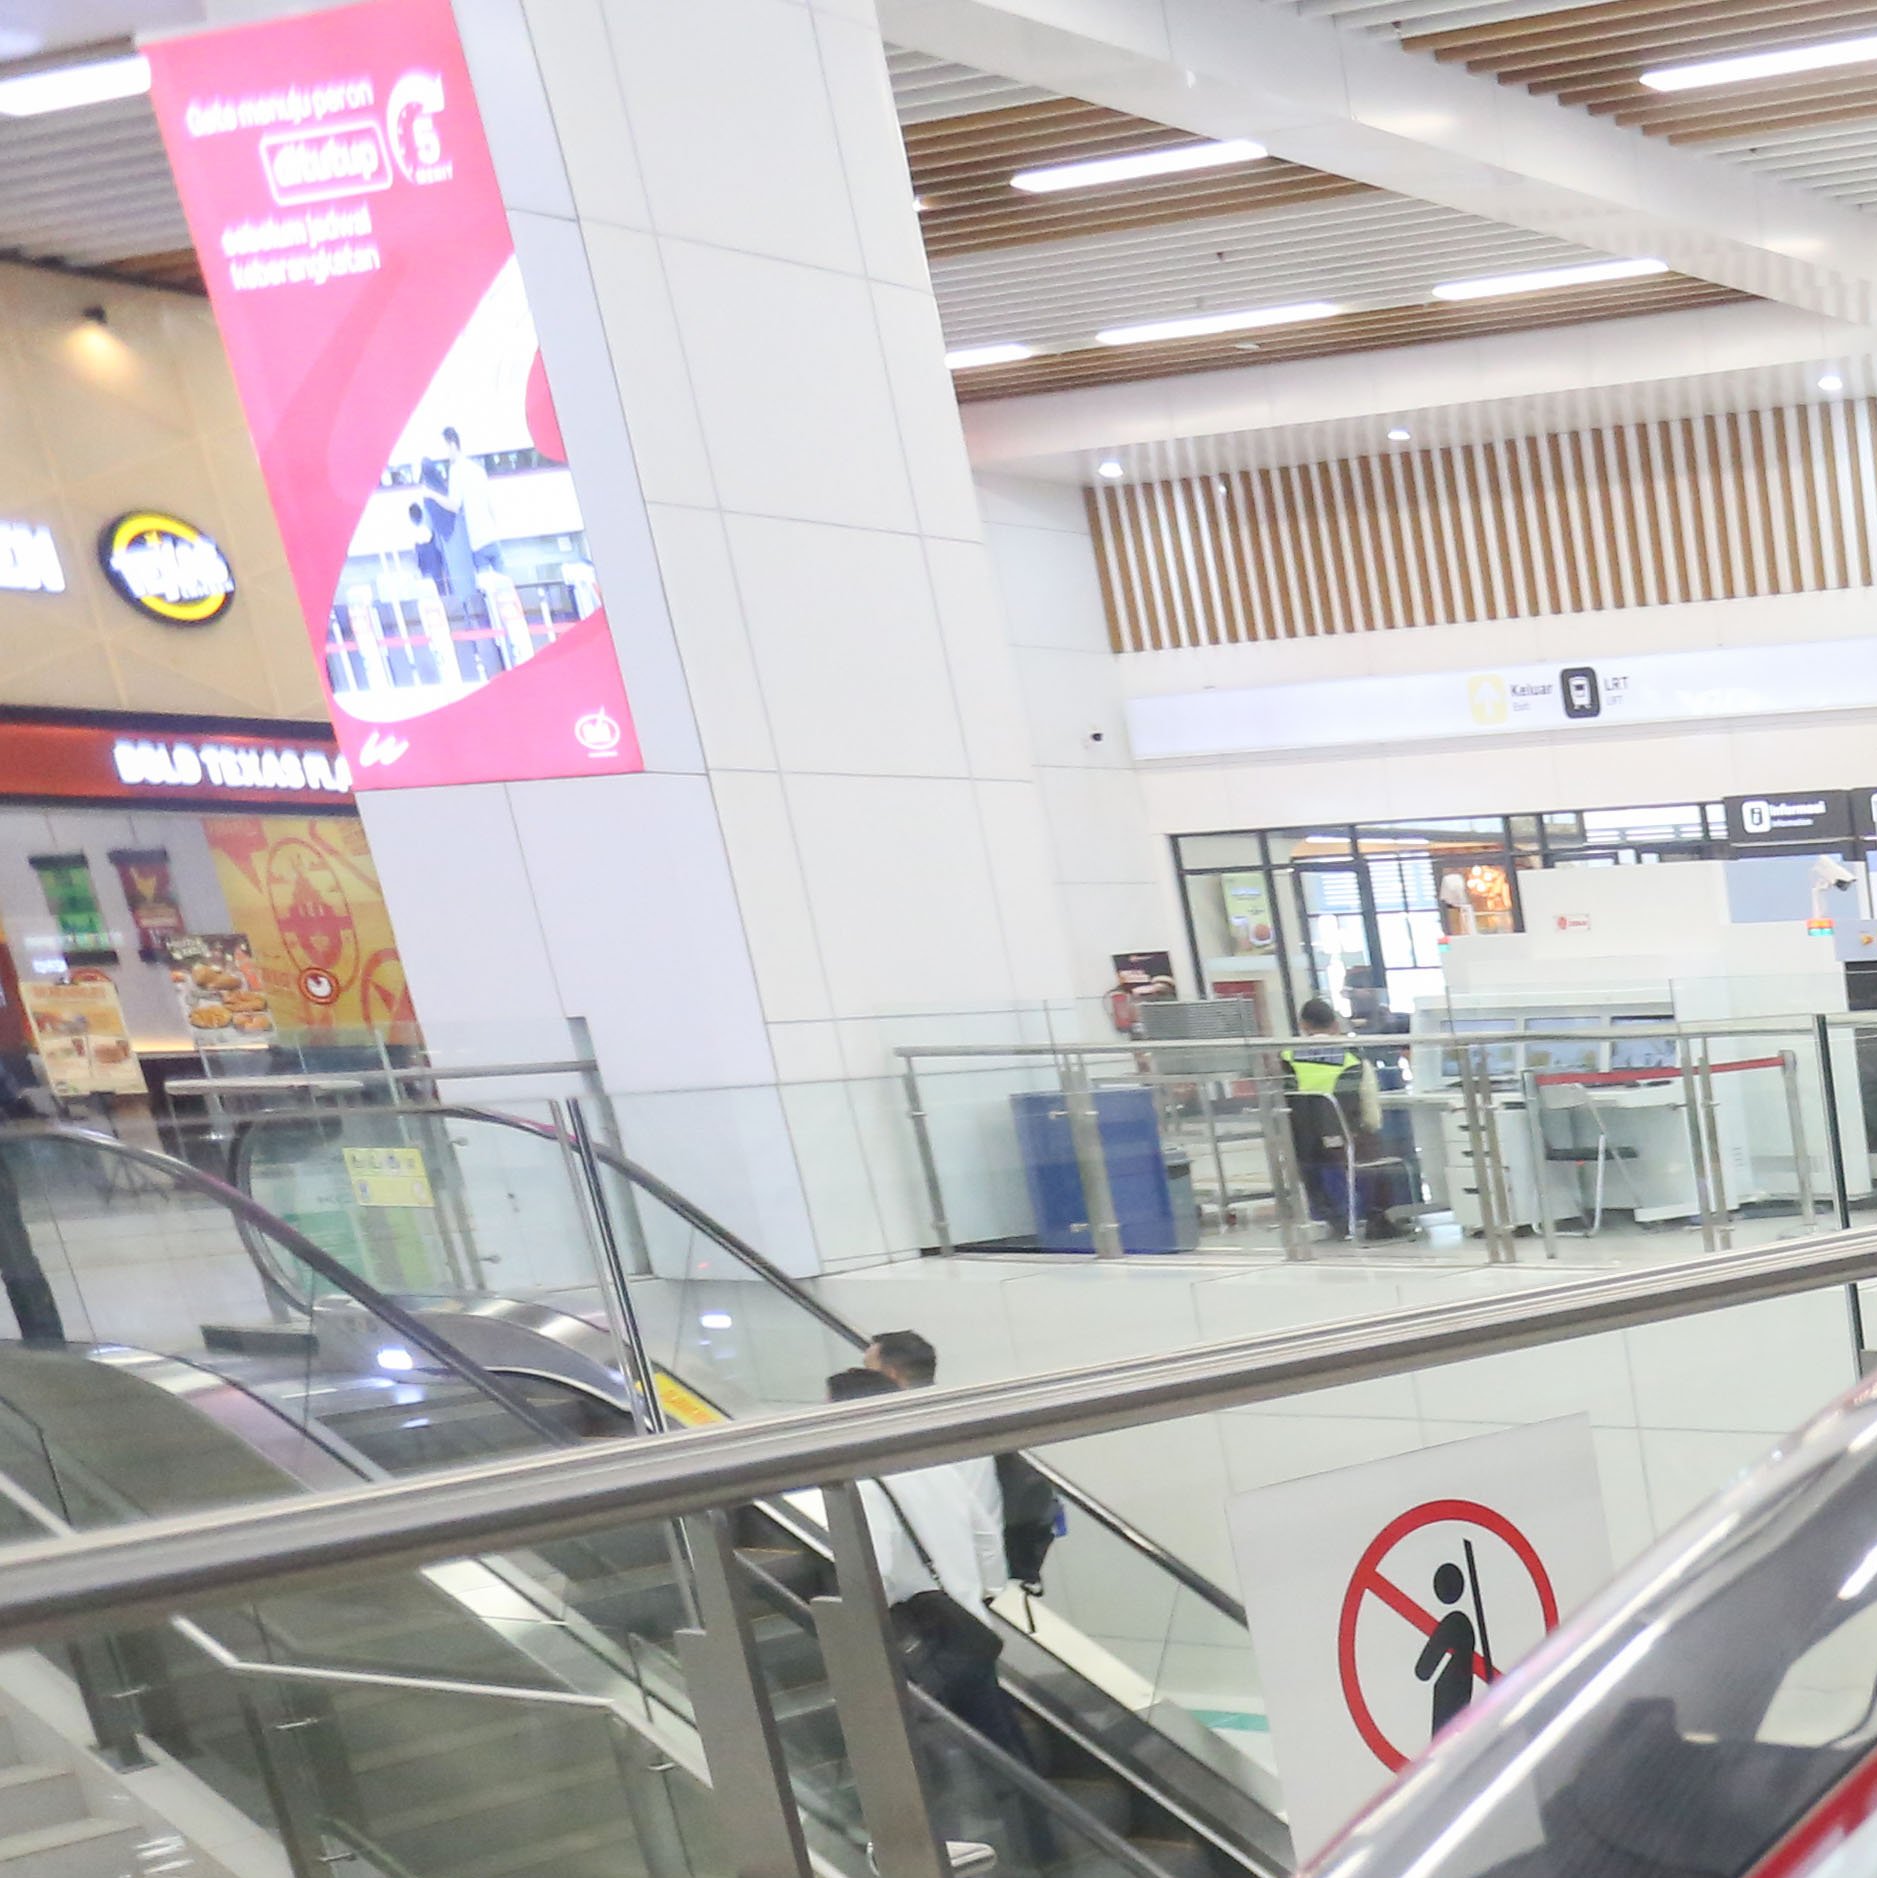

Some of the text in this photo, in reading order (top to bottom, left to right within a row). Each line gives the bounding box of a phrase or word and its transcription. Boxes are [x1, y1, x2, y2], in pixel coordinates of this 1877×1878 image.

[237, 84, 312, 126] menuju
[312, 78, 375, 120] peron
[273, 135, 379, 188] ditutup
[412, 115, 441, 165] 5
[305, 201, 373, 249] jadwal
[230, 243, 382, 291] keberangkatan
[1510, 681, 1554, 698] Keluar
[1604, 675, 1630, 692] LRT
[112, 738, 203, 785] BOLD
[200, 742, 304, 791] TEXAS
